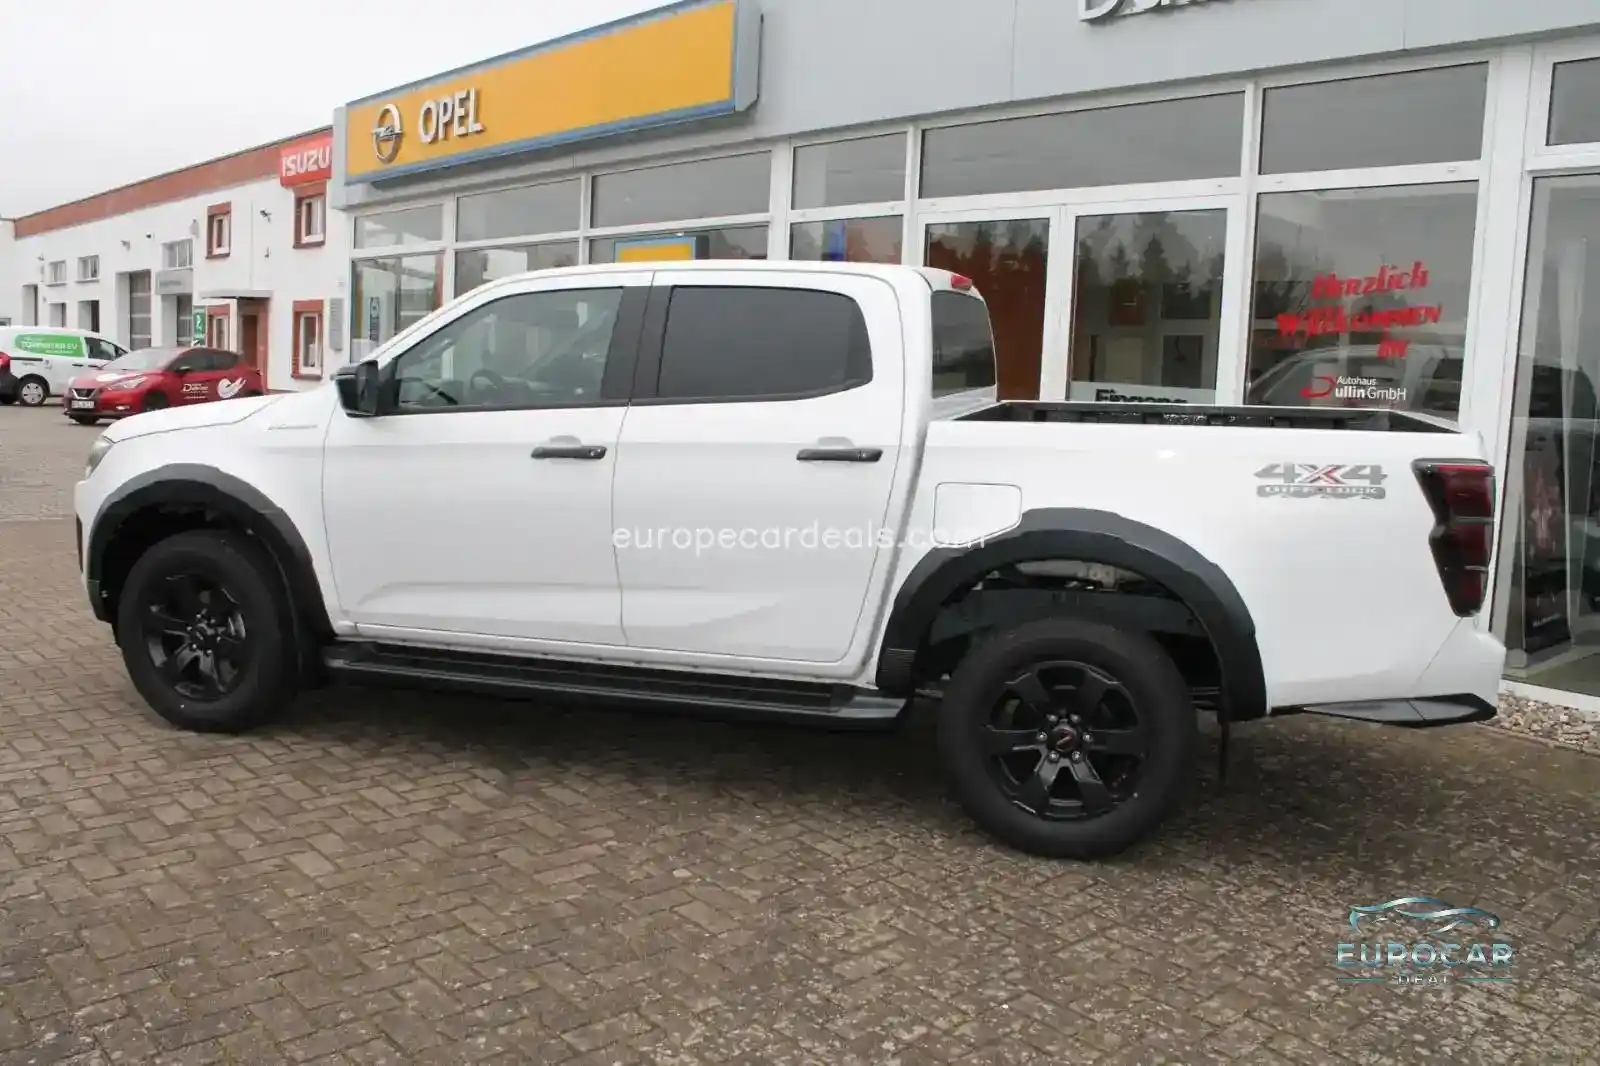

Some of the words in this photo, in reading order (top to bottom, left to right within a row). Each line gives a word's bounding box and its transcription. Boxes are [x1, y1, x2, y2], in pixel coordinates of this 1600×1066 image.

[418, 86, 484, 144] OPEL
[282, 145, 331, 177] ISUZU
[1337, 376, 1377, 385] Autohaus
